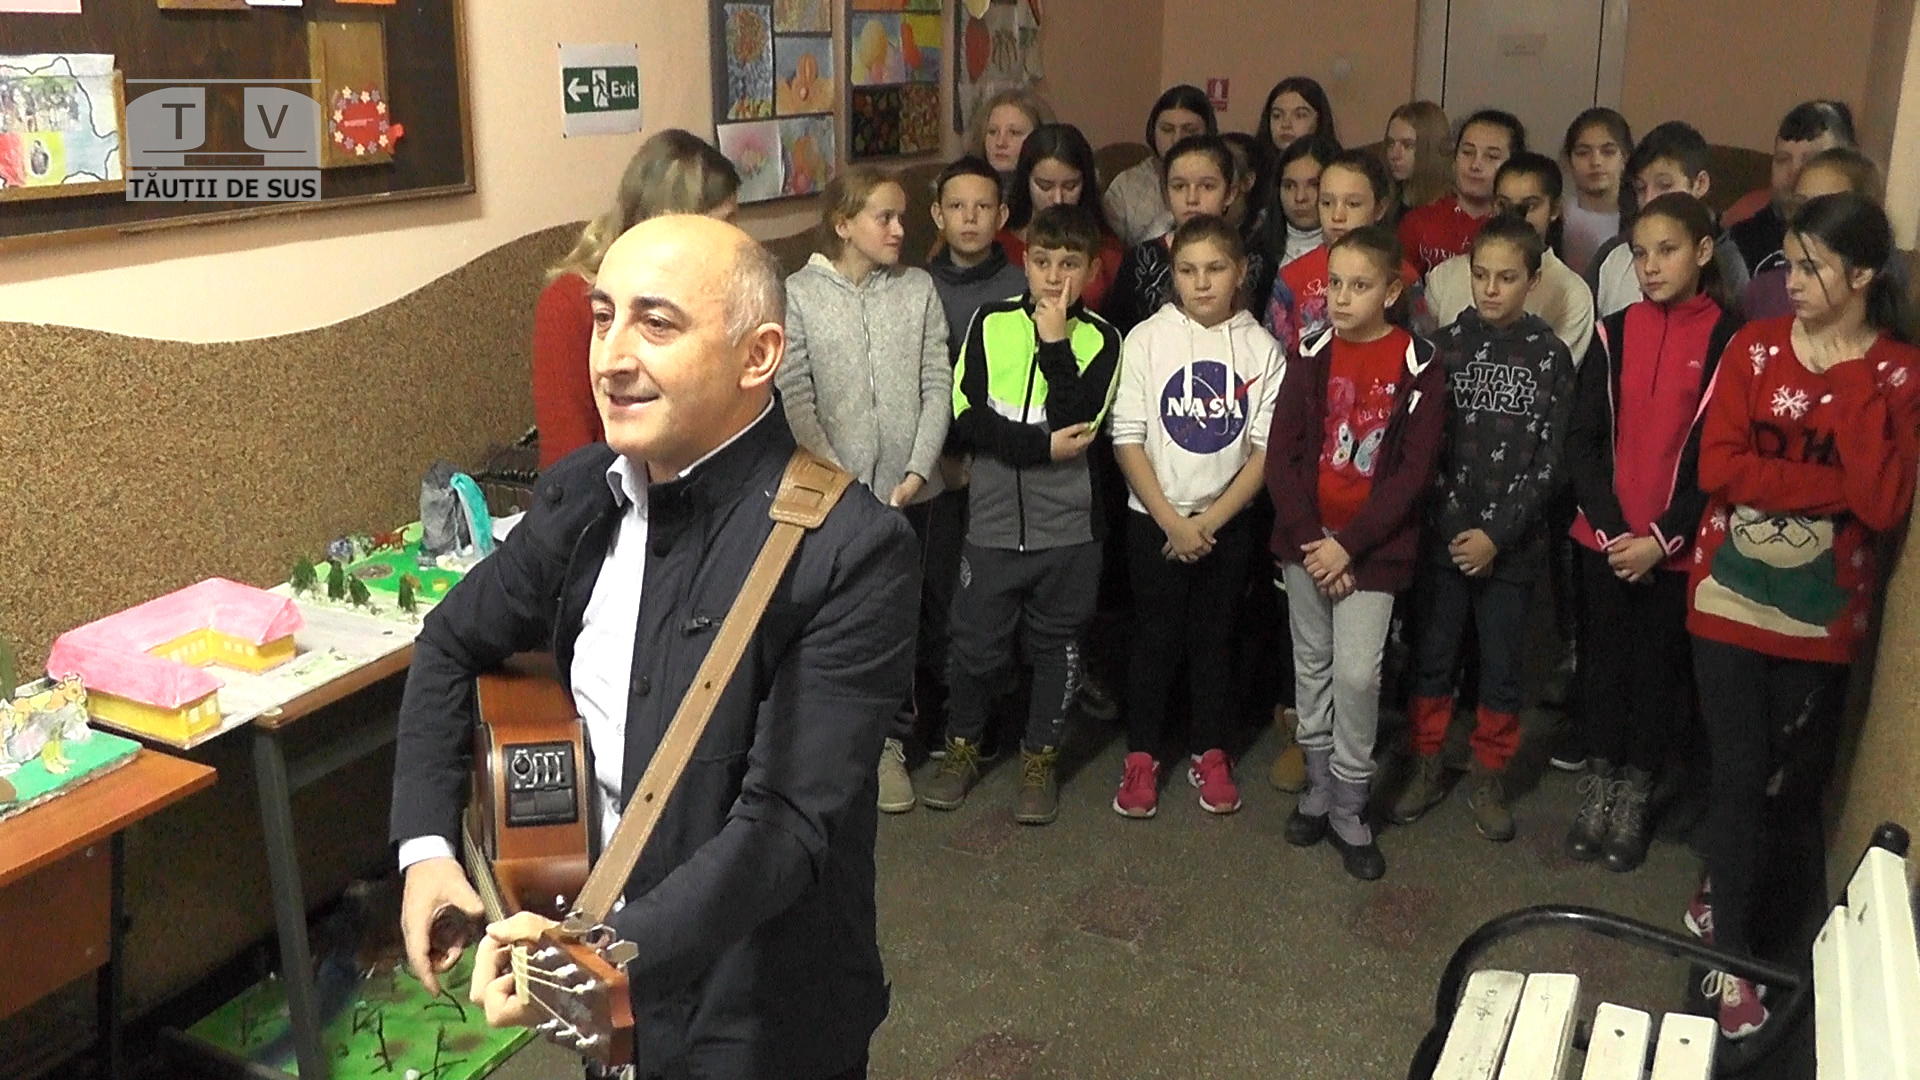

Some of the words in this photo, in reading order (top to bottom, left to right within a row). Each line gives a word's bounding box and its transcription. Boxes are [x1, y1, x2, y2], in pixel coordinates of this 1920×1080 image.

[611, 80, 636, 99] Exit
[1454, 361, 1537, 390] STAR
[1166, 397, 1244, 419] NASA
[1454, 386, 1534, 415] WARS
